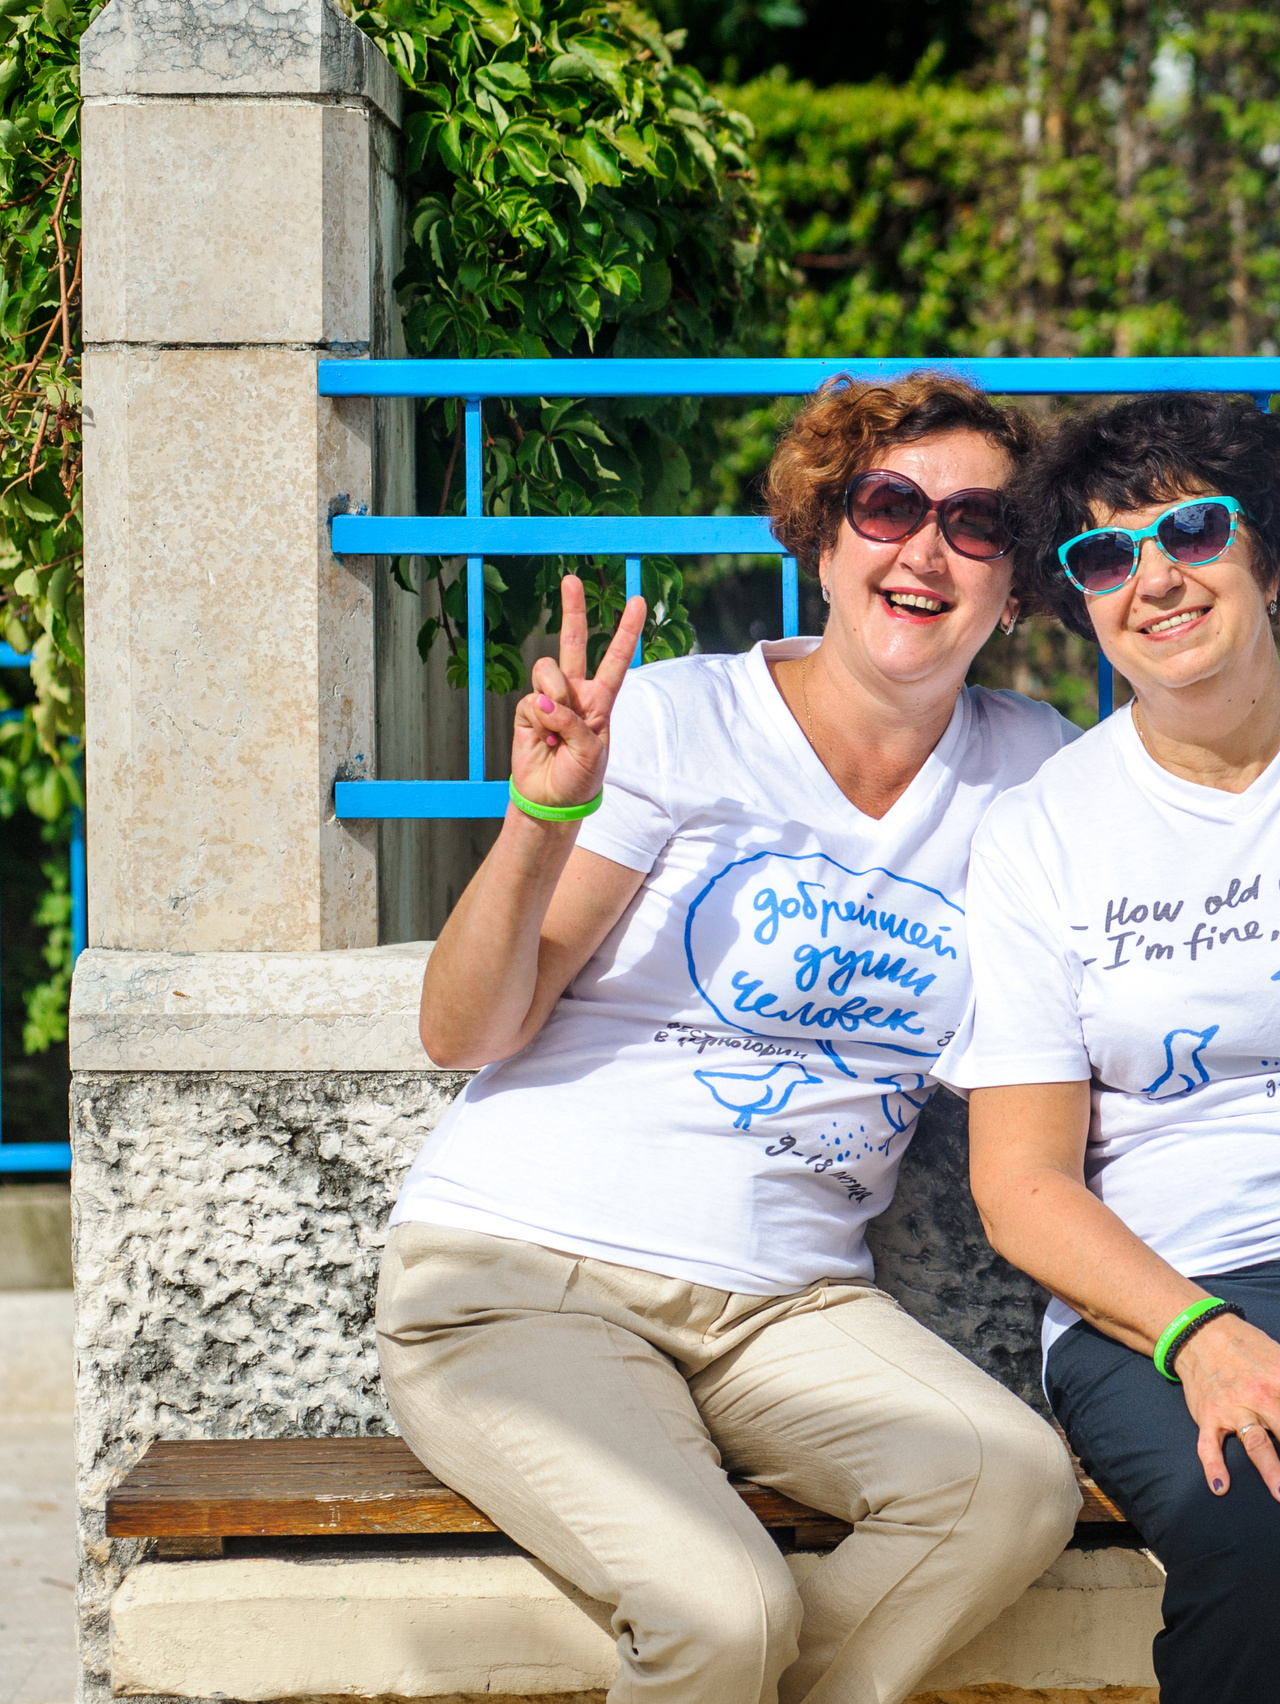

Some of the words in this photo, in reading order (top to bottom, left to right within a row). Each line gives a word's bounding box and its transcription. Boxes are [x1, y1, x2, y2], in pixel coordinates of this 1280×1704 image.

[524, 804, 566, 819] Happiness
[1104, 896, 1185, 933] How
[1204, 874, 1262, 916] old
[1102, 931, 1175, 971] I'm
[1182, 922, 1280, 961] fine,
[792, 943, 938, 997] души
[765, 1134, 834, 1174] 9-18
[1163, 1314, 1190, 1342] Возраст
